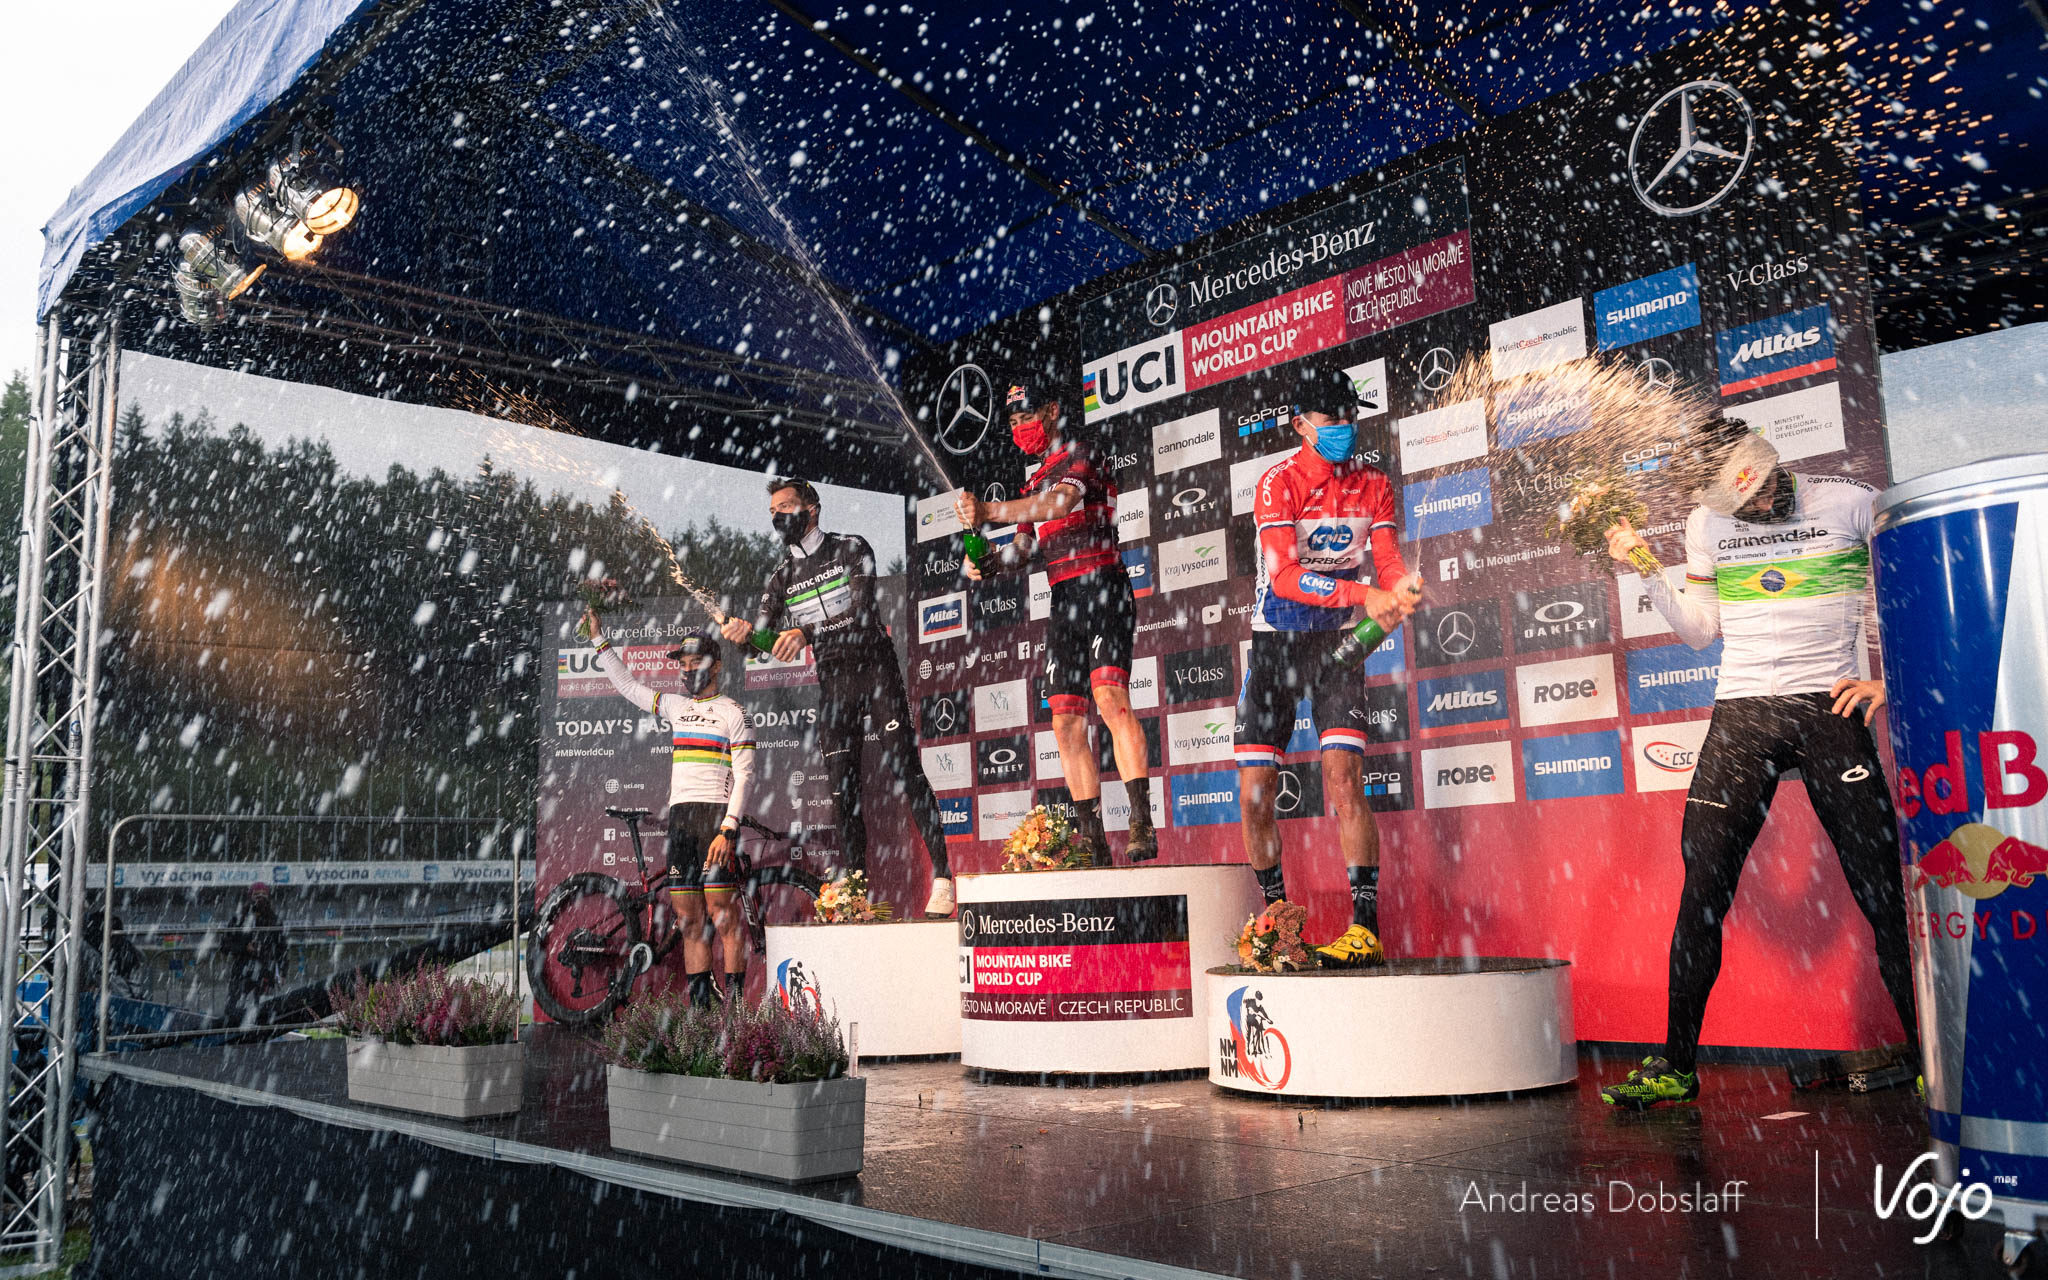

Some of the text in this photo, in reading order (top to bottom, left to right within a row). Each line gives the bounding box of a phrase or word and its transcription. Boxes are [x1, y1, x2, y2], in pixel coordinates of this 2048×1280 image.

[1189, 221, 1375, 309] Mercedes-Benz
[1347, 240, 1465, 300] NOVÉ MĚSTO NA MORAVĚ
[1727, 255, 1809, 292] V-Class
[1349, 287, 1423, 324] CZECH REPUBLIC
[1606, 291, 1687, 326] SHIMANO
[1191, 290, 1335, 354] MOUNTAIN BIKE
[1192, 329, 1298, 377] WORLD CUP
[1730, 326, 1822, 366] Mitas
[1099, 345, 1177, 405] UCI
[1238, 405, 1289, 426] GoPro
[1774, 414, 1804, 425] MINISTRY
[1785, 419, 1818, 430] REGIONAL
[1775, 421, 1833, 440] DEVELOPMENT CZ
[1158, 431, 1215, 455] cannondale
[1623, 442, 1681, 463] GoPr
[1516, 469, 1584, 497] V-Class
[1807, 475, 1874, 493] cannondale
[1164, 501, 1216, 521] OAKLEY
[1413, 491, 1482, 518] SHIMANO
[1119, 509, 1145, 524] ndale
[1311, 531, 1351, 546] KMC
[1718, 526, 1829, 550] cannondale
[924, 558, 960, 577] V-Class
[1299, 557, 1351, 565] ORBEA
[1466, 545, 1561, 571] UCI Mountainbike
[1301, 575, 1335, 592] KMC
[979, 598, 1018, 616] V-Class
[926, 610, 960, 625] Mitas
[1133, 617, 1188, 636] _mountainbike
[1524, 617, 1598, 638] OAKLEY
[627, 650, 669, 660] MOUNT
[981, 650, 1008, 663] UCI_MTB
[1035, 642, 1046, 652] UCI
[569, 653, 605, 673] UC
[627, 661, 680, 671] WORLD CU
[1128, 678, 1152, 690] ndale
[1175, 667, 1224, 685] V-Class
[1427, 689, 1498, 712] Mitas
[752, 709, 816, 727] ODAY'S
[1368, 707, 1397, 724] lass
[556, 719, 633, 736] TODAY'S
[555, 748, 614, 757] #MBWorldCup
[756, 740, 799, 749] BWorldCup
[1535, 756, 1611, 776] SHIMANO
[1672, 752, 1694, 766] CSC
[983, 763, 1024, 775] OAKLEY
[1362, 772, 1400, 784] Pro
[1898, 730, 1969, 819] ed
[1179, 790, 1233, 807] SHIMANO
[940, 810, 968, 824] itas
[978, 912, 1115, 936] Mercedes-Benz
[1915, 910, 1993, 940] ERGY
[976, 954, 1072, 969] MOUNTAIN BIKE
[977, 972, 1043, 986] WORLD CUP
[980, 1001, 993, 1014] NA
[995, 998, 1047, 1015] MORAVĚ
[1058, 1000, 1109, 1016] CZECH
[1114, 997, 1184, 1014] REPUBLIC
[1220, 1038, 1237, 1058] NM
[1220, 1058, 1239, 1078] NM
